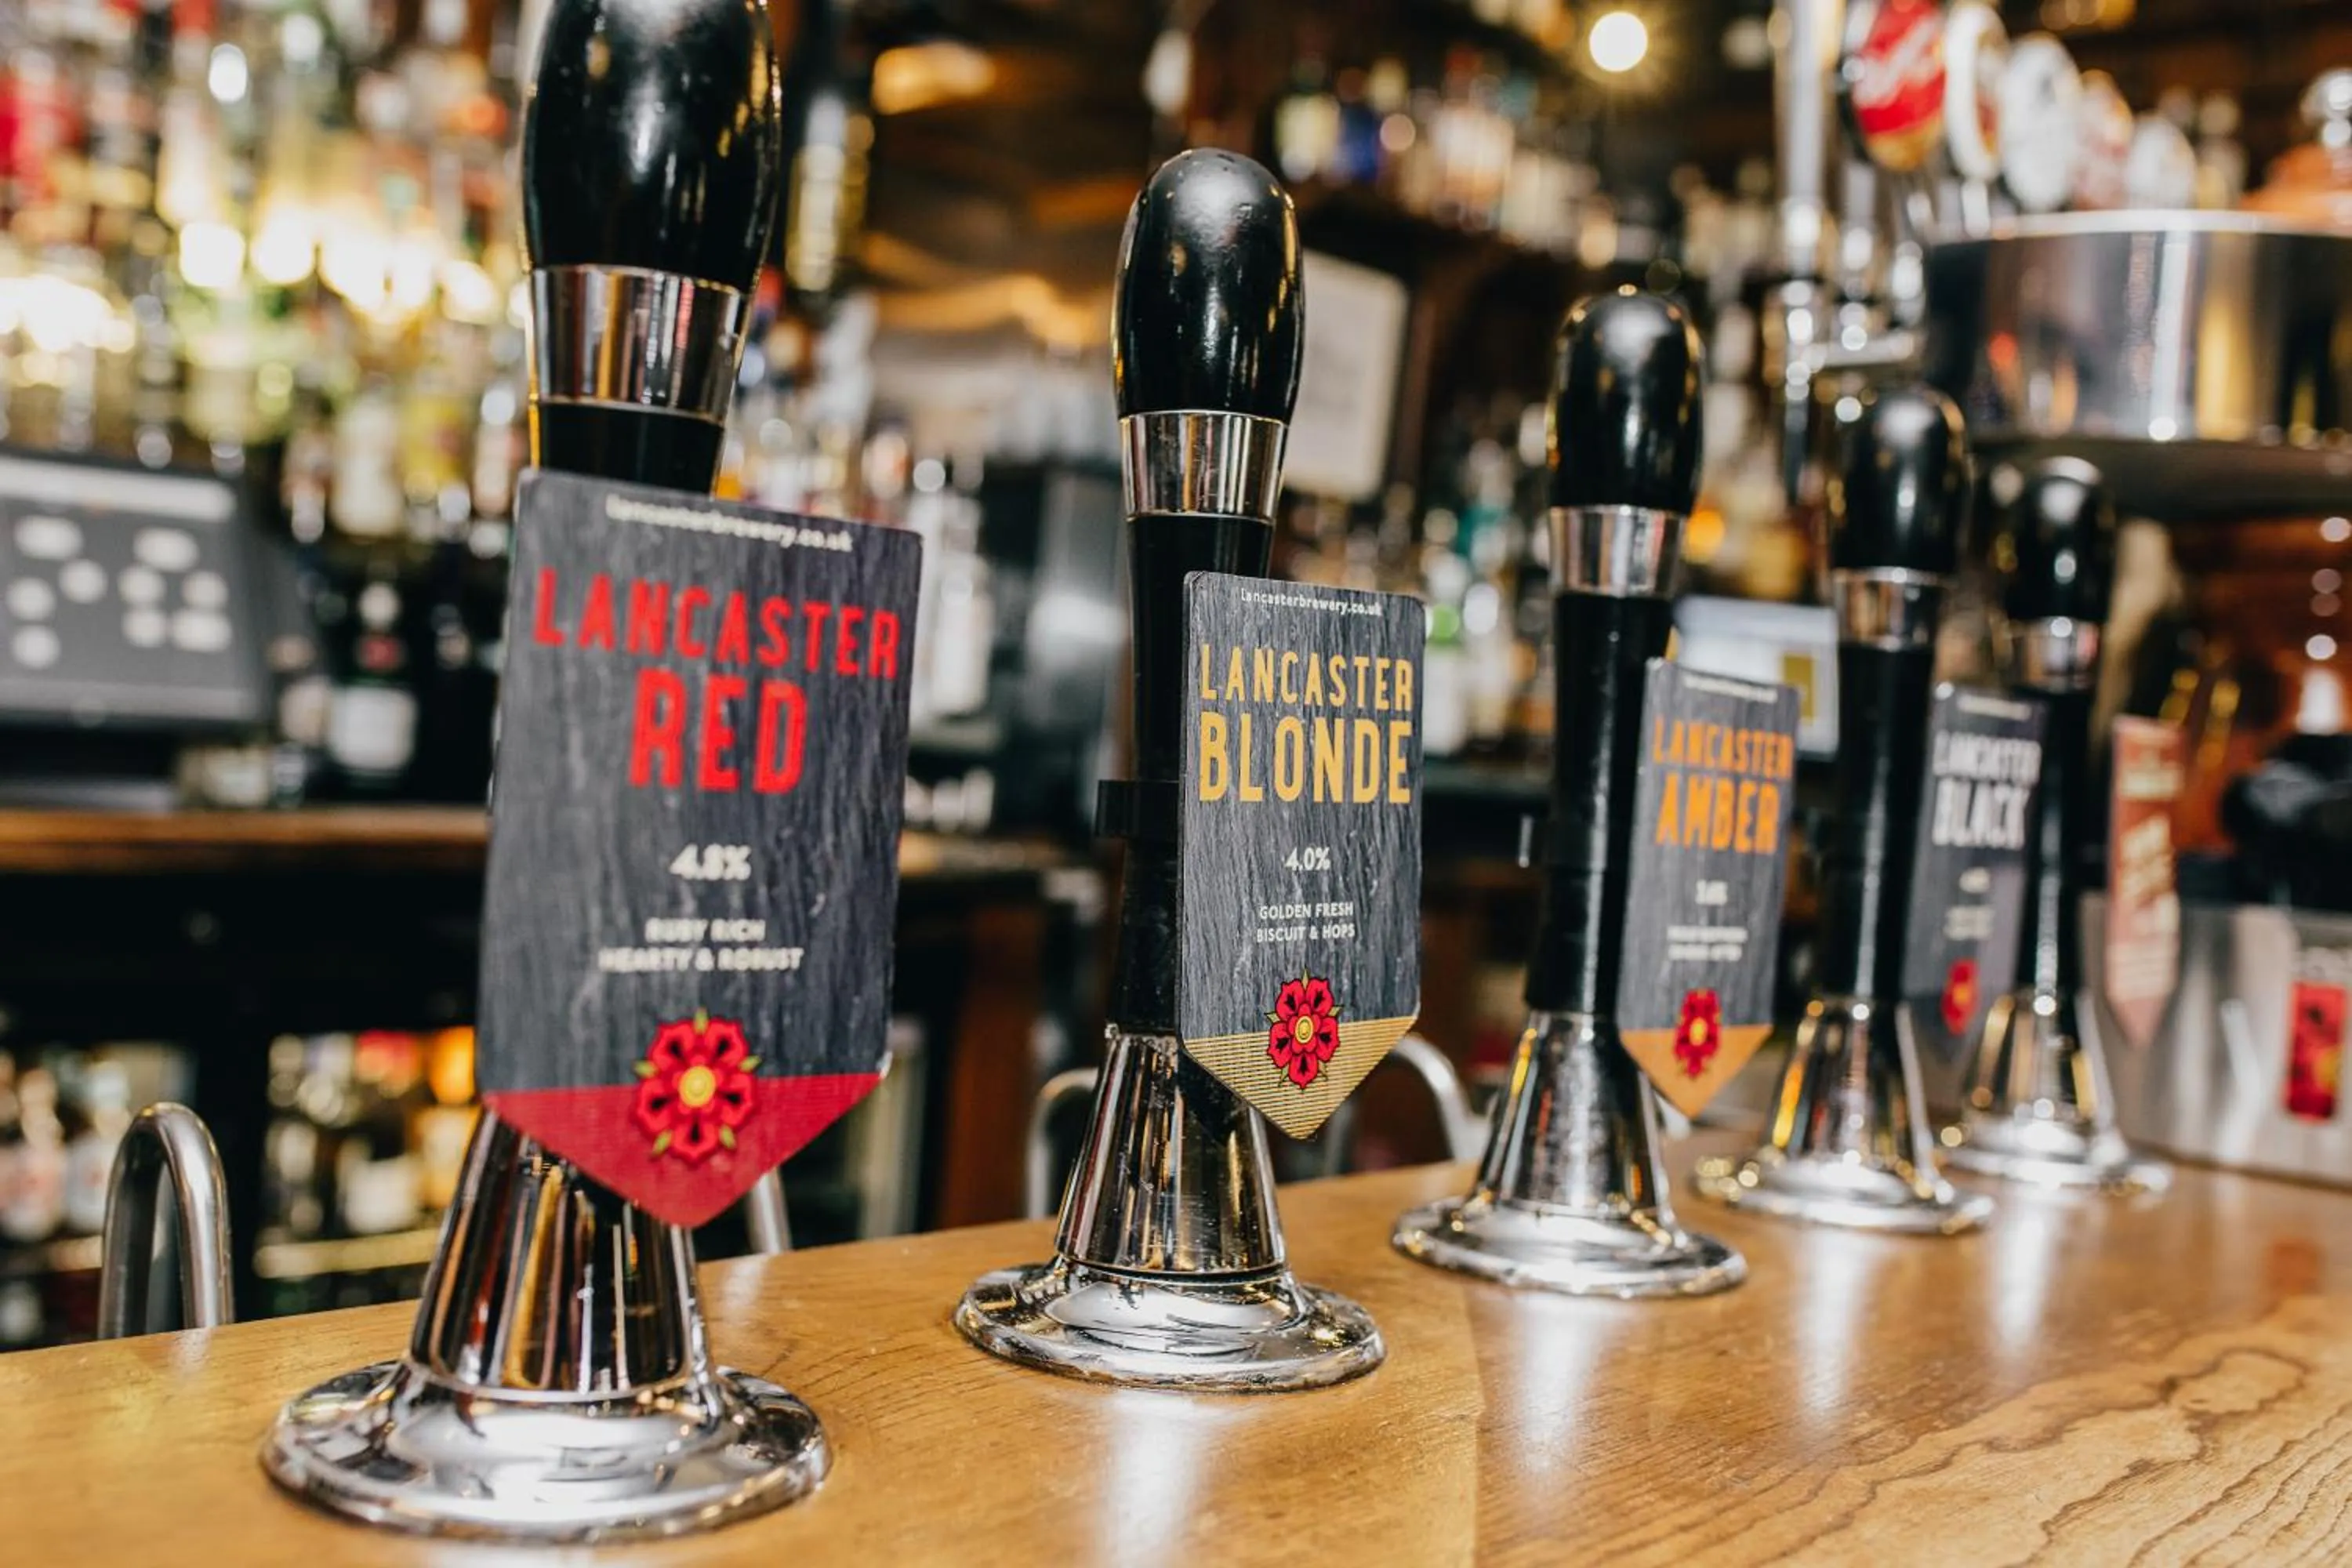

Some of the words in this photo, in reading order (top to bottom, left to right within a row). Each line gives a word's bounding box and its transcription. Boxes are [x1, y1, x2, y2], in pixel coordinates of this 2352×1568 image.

[533, 568, 900, 680] LANCASTER
[1241, 588, 1383, 615] lancasterbrewery.co.uk
[1200, 644, 1413, 710] LANCASTER
[630, 667, 808, 794] RED
[1199, 711, 1412, 803] BLONDE
[1653, 714, 1793, 779] LANCASTER
[1655, 771, 1779, 855] AMBER
[1285, 847, 1330, 871] 4.0%
[1257, 926, 1305, 942] BISCUIT
[1309, 925, 1318, 940] &
[1323, 923, 1355, 939] HOPS
[1259, 904, 1312, 920] GOLDEN
[1316, 902, 1353, 917] FRESH
